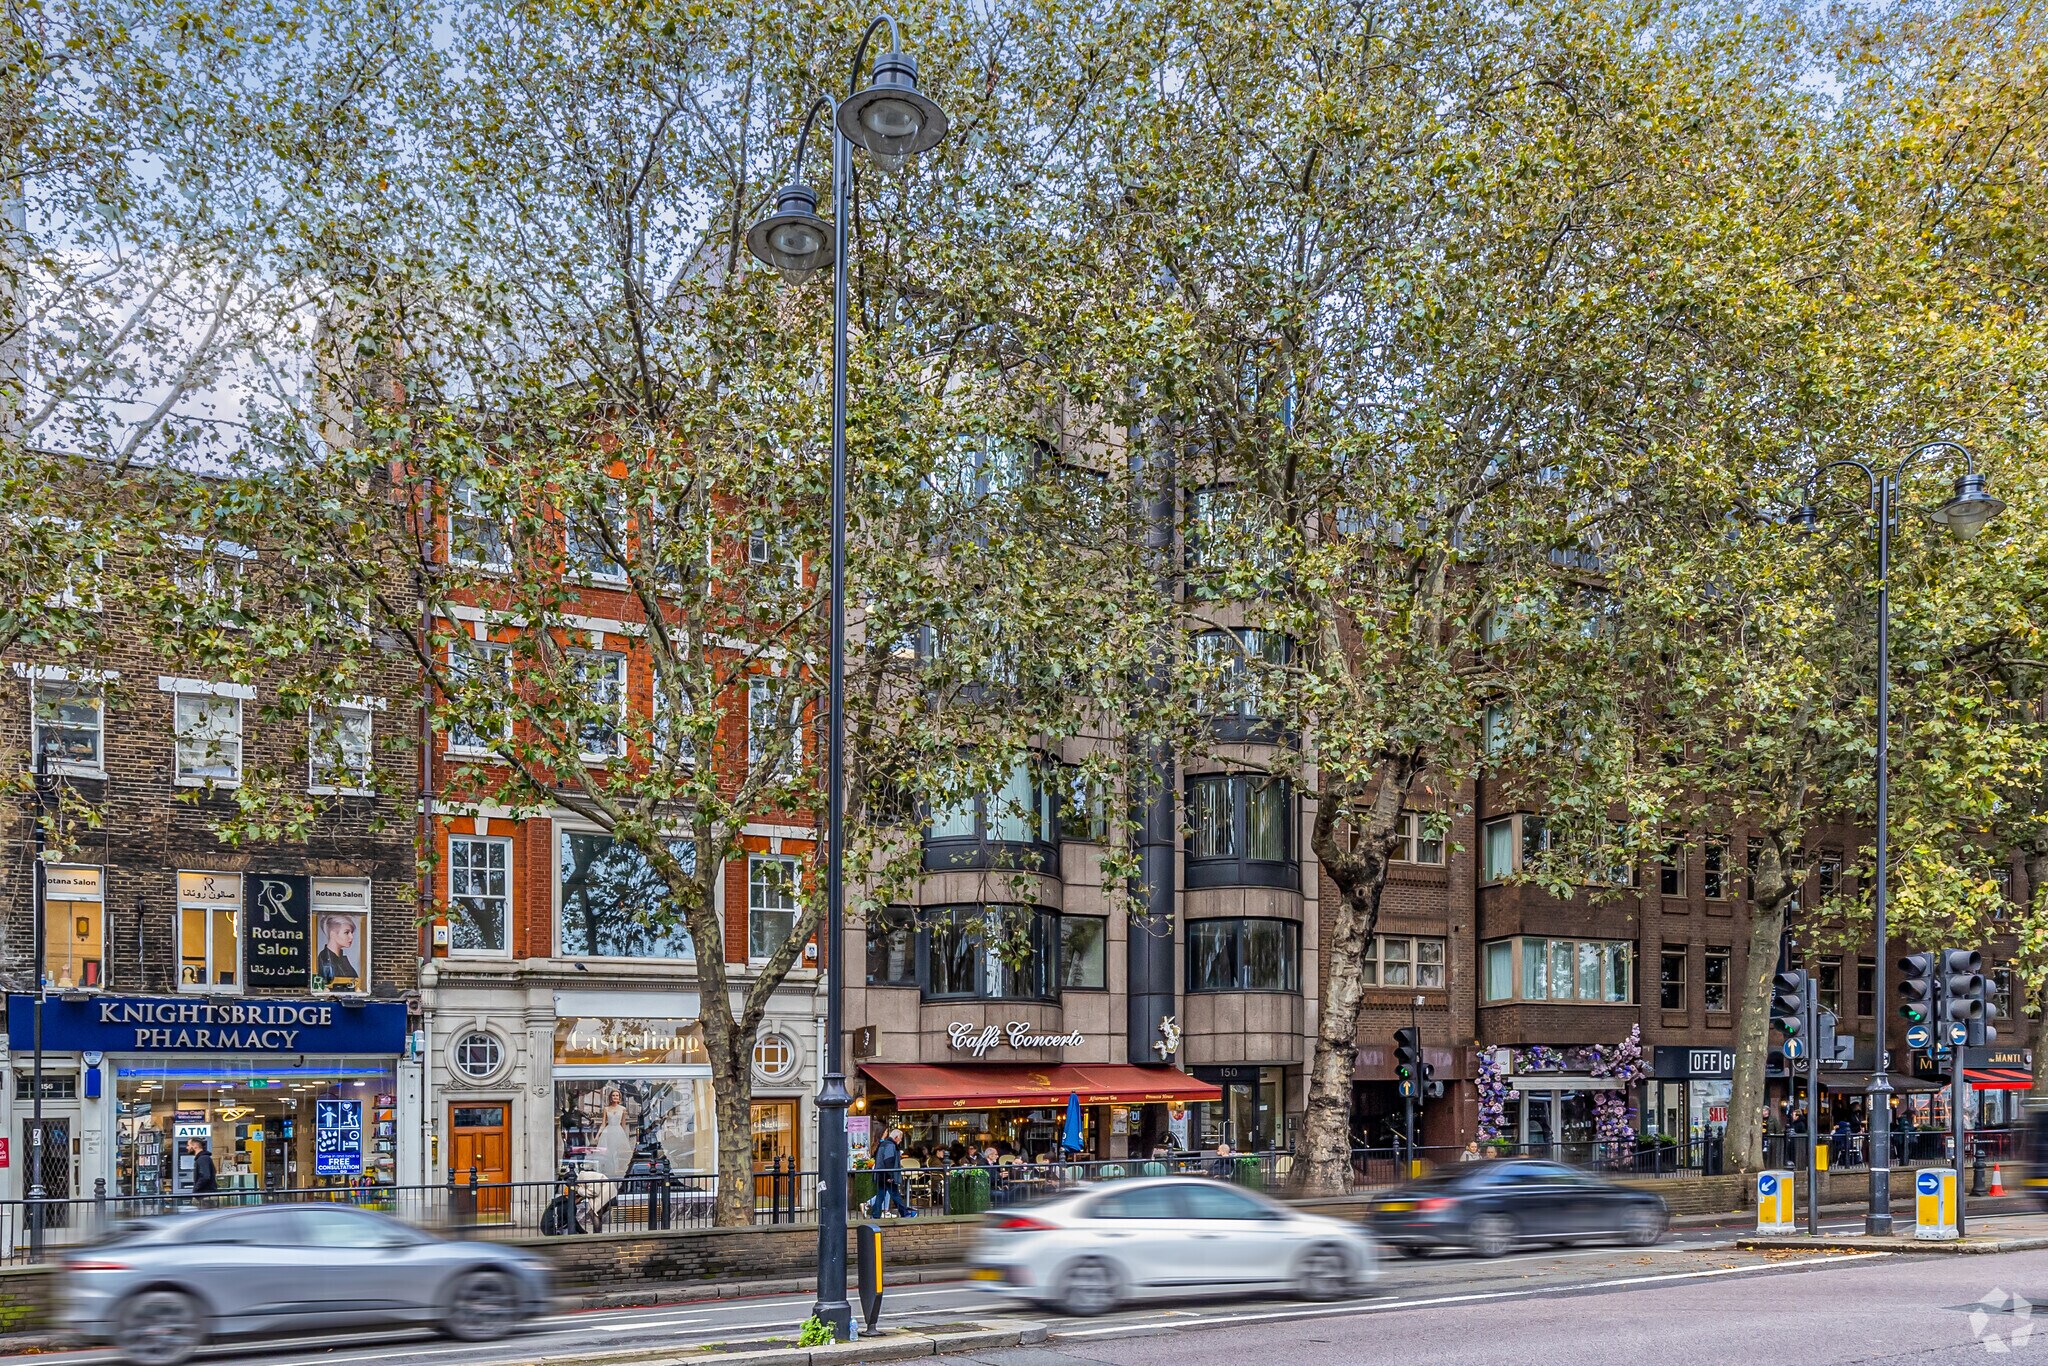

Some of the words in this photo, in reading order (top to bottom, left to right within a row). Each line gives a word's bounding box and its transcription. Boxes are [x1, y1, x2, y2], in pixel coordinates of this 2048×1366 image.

[73, 878, 96, 886] Salon
[252, 926, 304, 940] Rotana
[257, 943, 299, 956] Salon
[100, 1003, 332, 1025] KNIGHTSBRIDGE
[134, 1028, 299, 1049] PHARMACY
[1006, 1021, 1086, 1050] Concerto
[571, 1030, 699, 1057] Castigliano
[1694, 1054, 1717, 1071] OFF
[1220, 1068, 1238, 1077] 150
[179, 1128, 207, 1136] ATM
